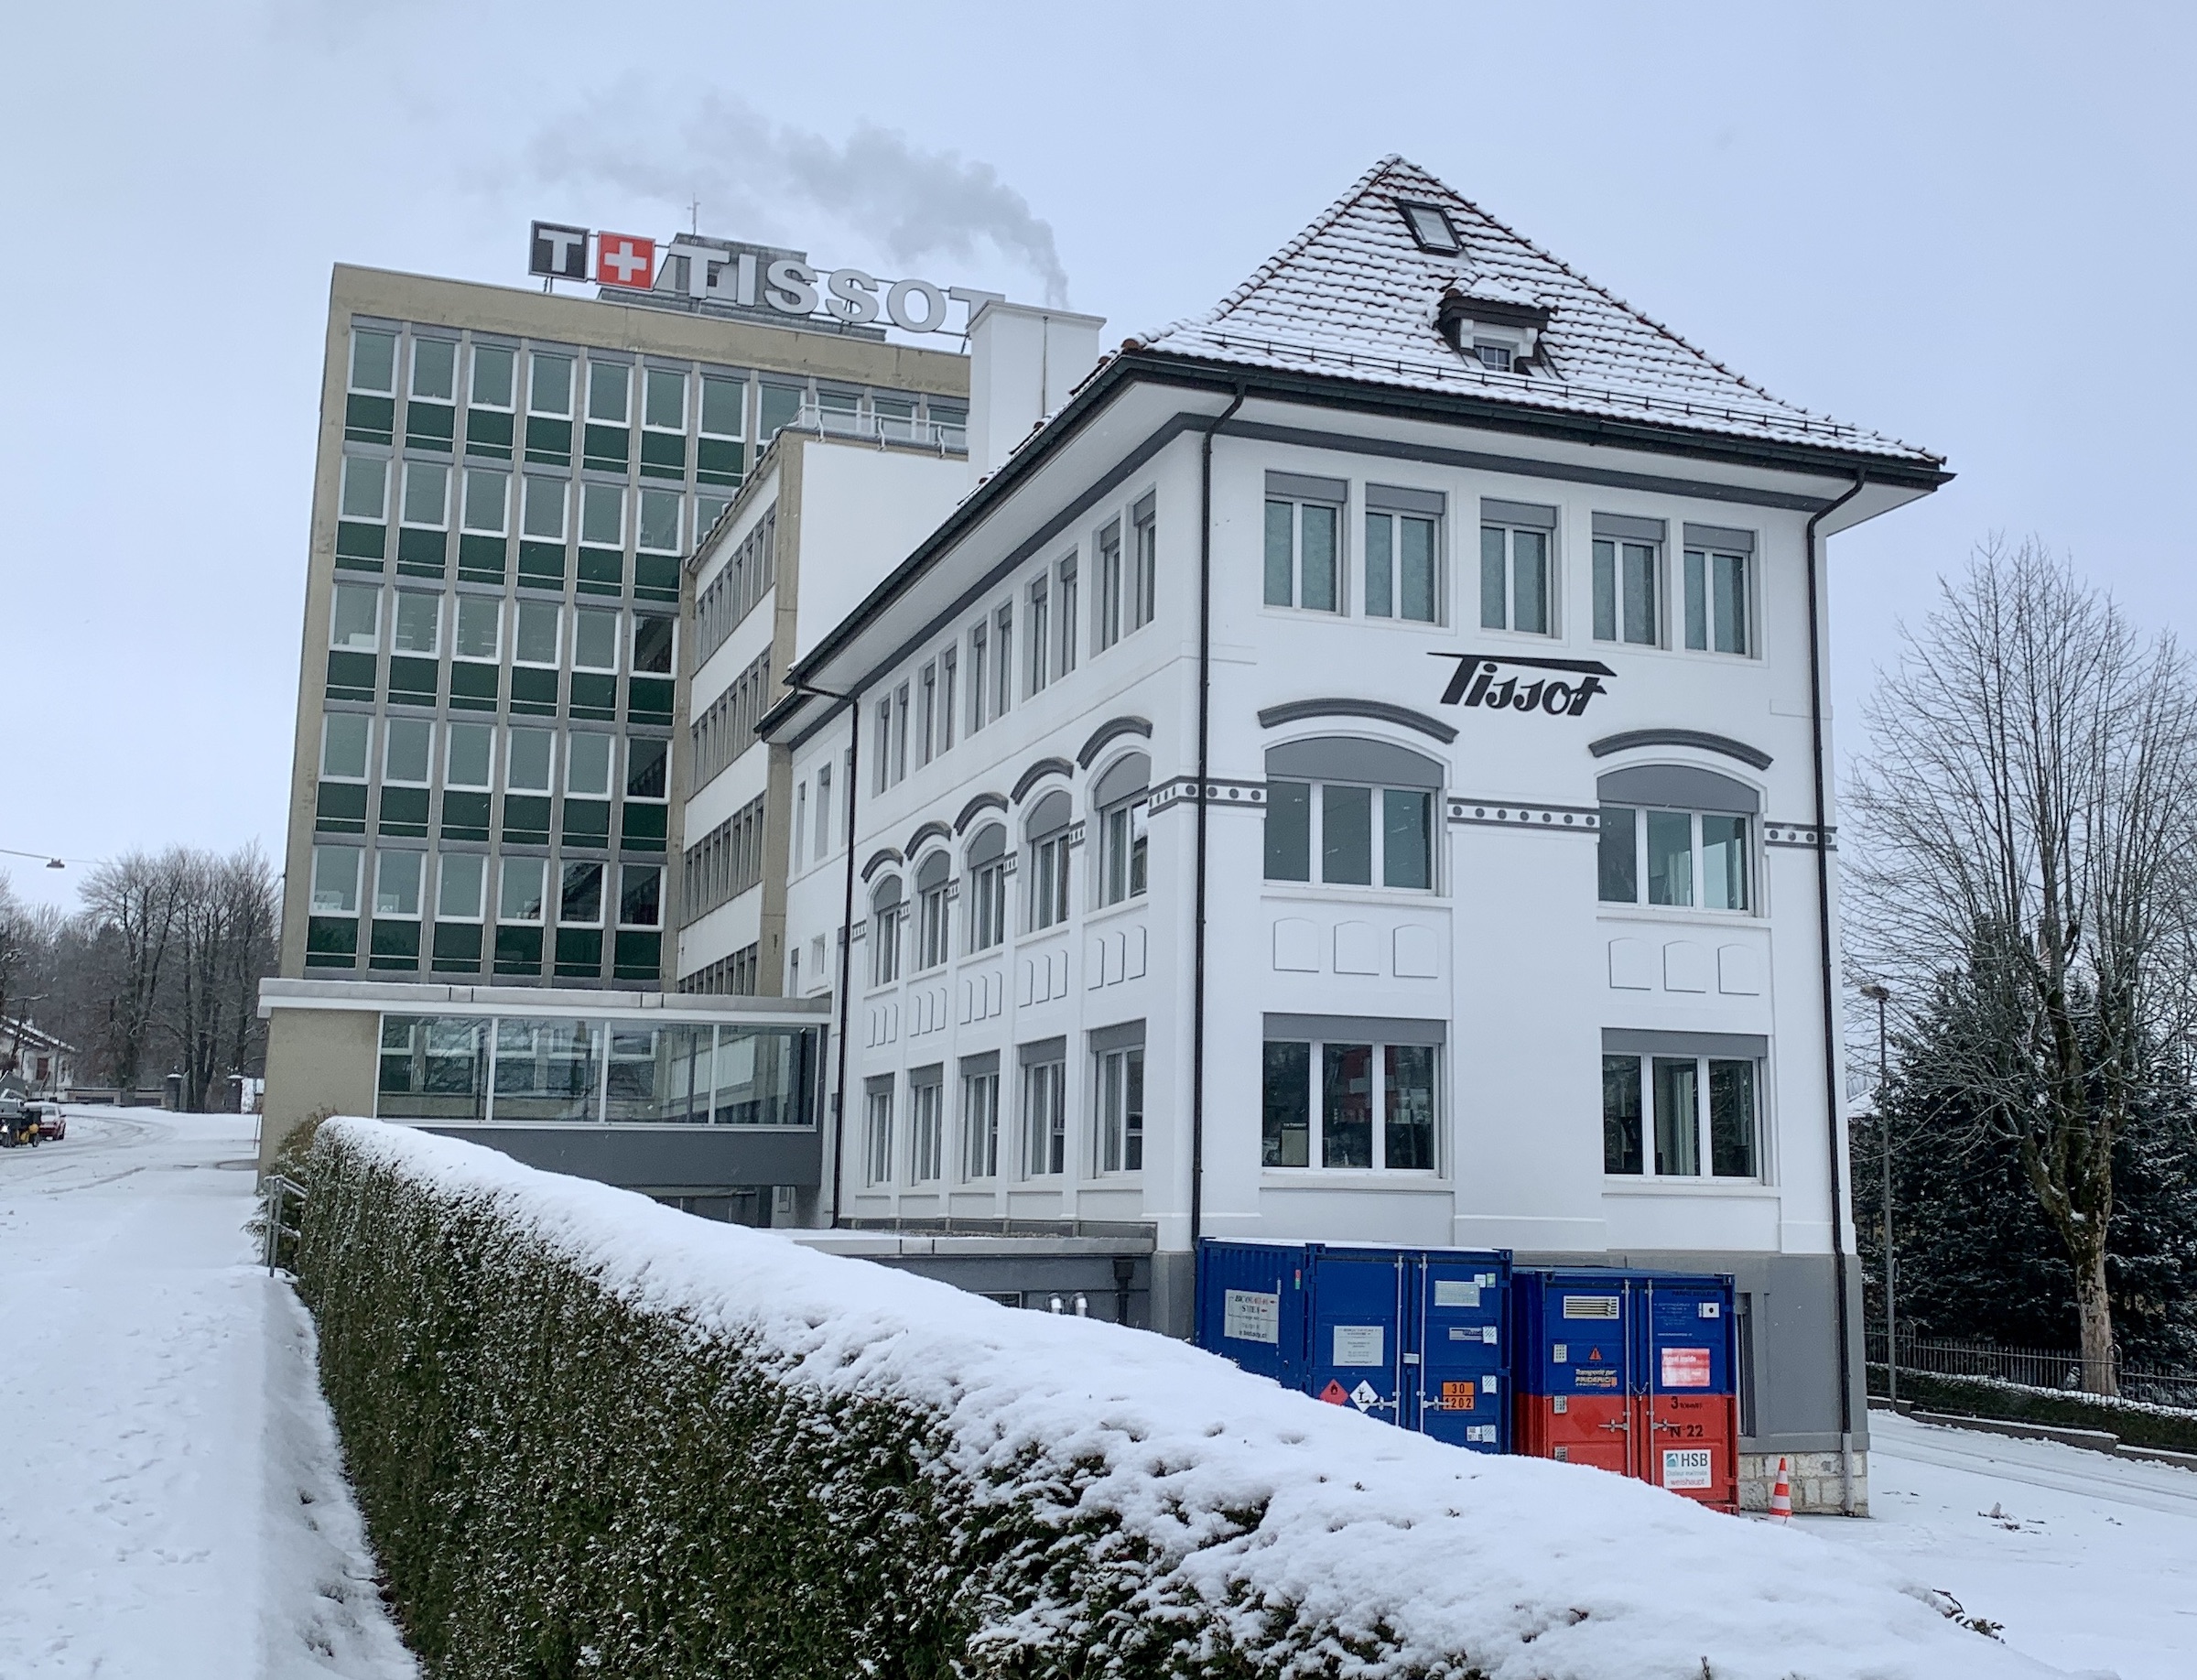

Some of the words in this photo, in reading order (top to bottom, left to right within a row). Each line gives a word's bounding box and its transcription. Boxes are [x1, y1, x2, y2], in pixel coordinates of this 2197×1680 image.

[1426, 652, 1618, 716] Tissot
[1451, 1383, 1465, 1394] 30
[1445, 1397, 1472, 1409] 1202
[1681, 1453, 1708, 1467] HSB
